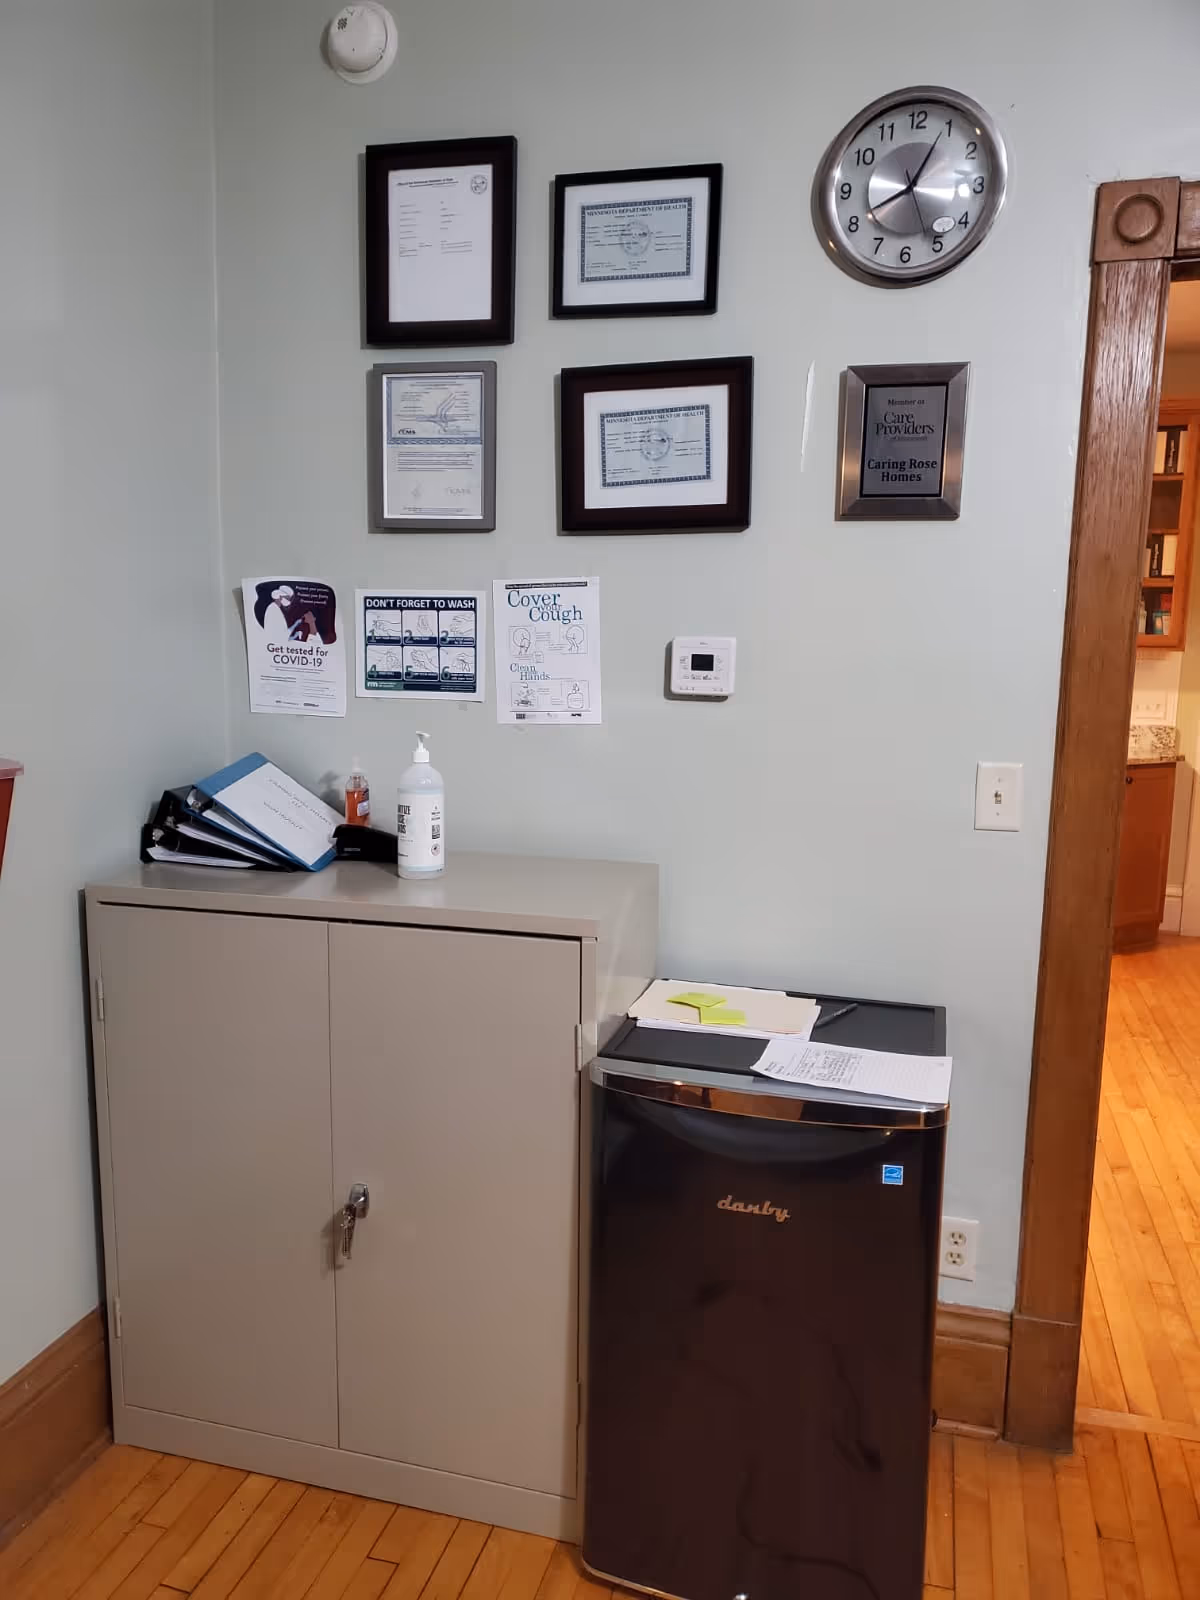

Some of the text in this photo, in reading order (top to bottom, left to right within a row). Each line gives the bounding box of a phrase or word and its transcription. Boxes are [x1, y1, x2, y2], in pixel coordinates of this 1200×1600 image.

[908, 111, 928, 130] 12
[945, 119, 953, 137] 1
[878, 122, 895, 141] 11
[854, 148, 875, 166] 10
[965, 142, 977, 160] 2
[840, 183, 852, 200] 9
[972, 176, 985, 194] 3
[848, 216, 859, 232] 8
[958, 211, 970, 229] 4
[873, 237, 884, 255] 7
[932, 235, 943, 253] 5
[900, 247, 911, 263] 6
[887, 398, 915, 406] Member
[883, 411, 914, 424] Care
[874, 420, 935, 436] Providers
[867, 458, 938, 472] Caring Rose
[881, 471, 922, 482] Homes
[366, 598, 475, 609] DON'T FORGET TO WASH
[507, 590, 561, 608] Cover
[529, 605, 583, 625] Cough
[368, 629, 377, 643] 1
[404, 630, 413, 644] 2
[266, 643, 328, 657] Get tested for
[273, 654, 322, 667] COVID-19
[510, 663, 536, 673] Clean
[368, 664, 377, 677] 4
[405, 665, 414, 679] 5
[441, 666, 450, 680] 6
[520, 671, 551, 681] Hands
[717, 1194, 791, 1223] danby
